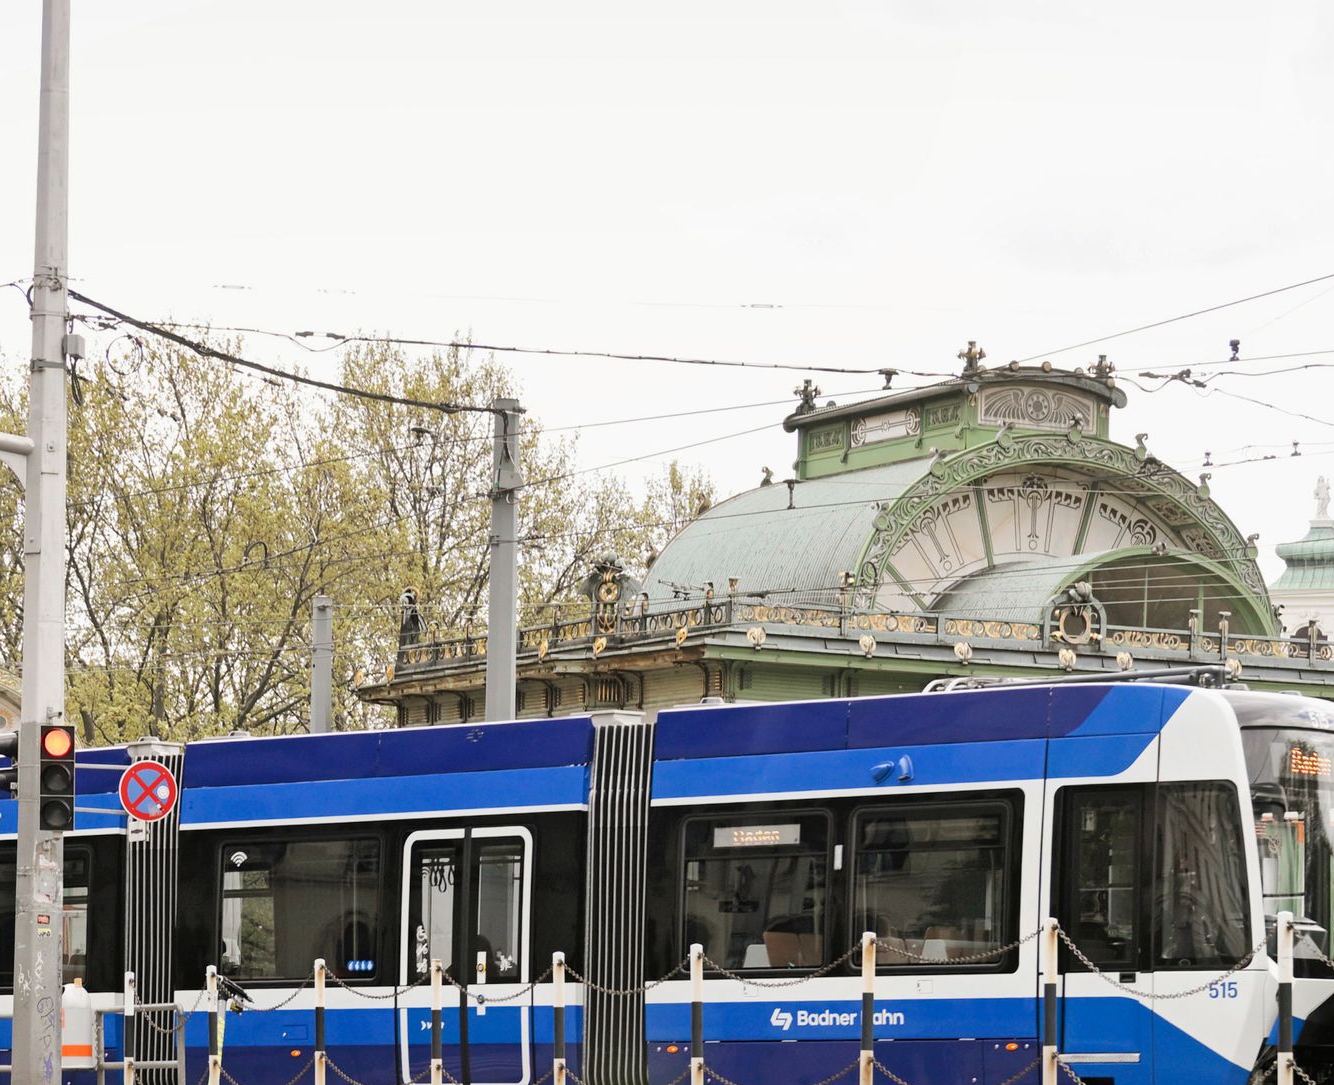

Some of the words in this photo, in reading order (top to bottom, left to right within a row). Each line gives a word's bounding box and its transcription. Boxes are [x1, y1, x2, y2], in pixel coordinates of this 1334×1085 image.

[1209, 981, 1238, 999] 515
[797, 1009, 857, 1026] Badner
[861, 1009, 904, 1026] ahn
